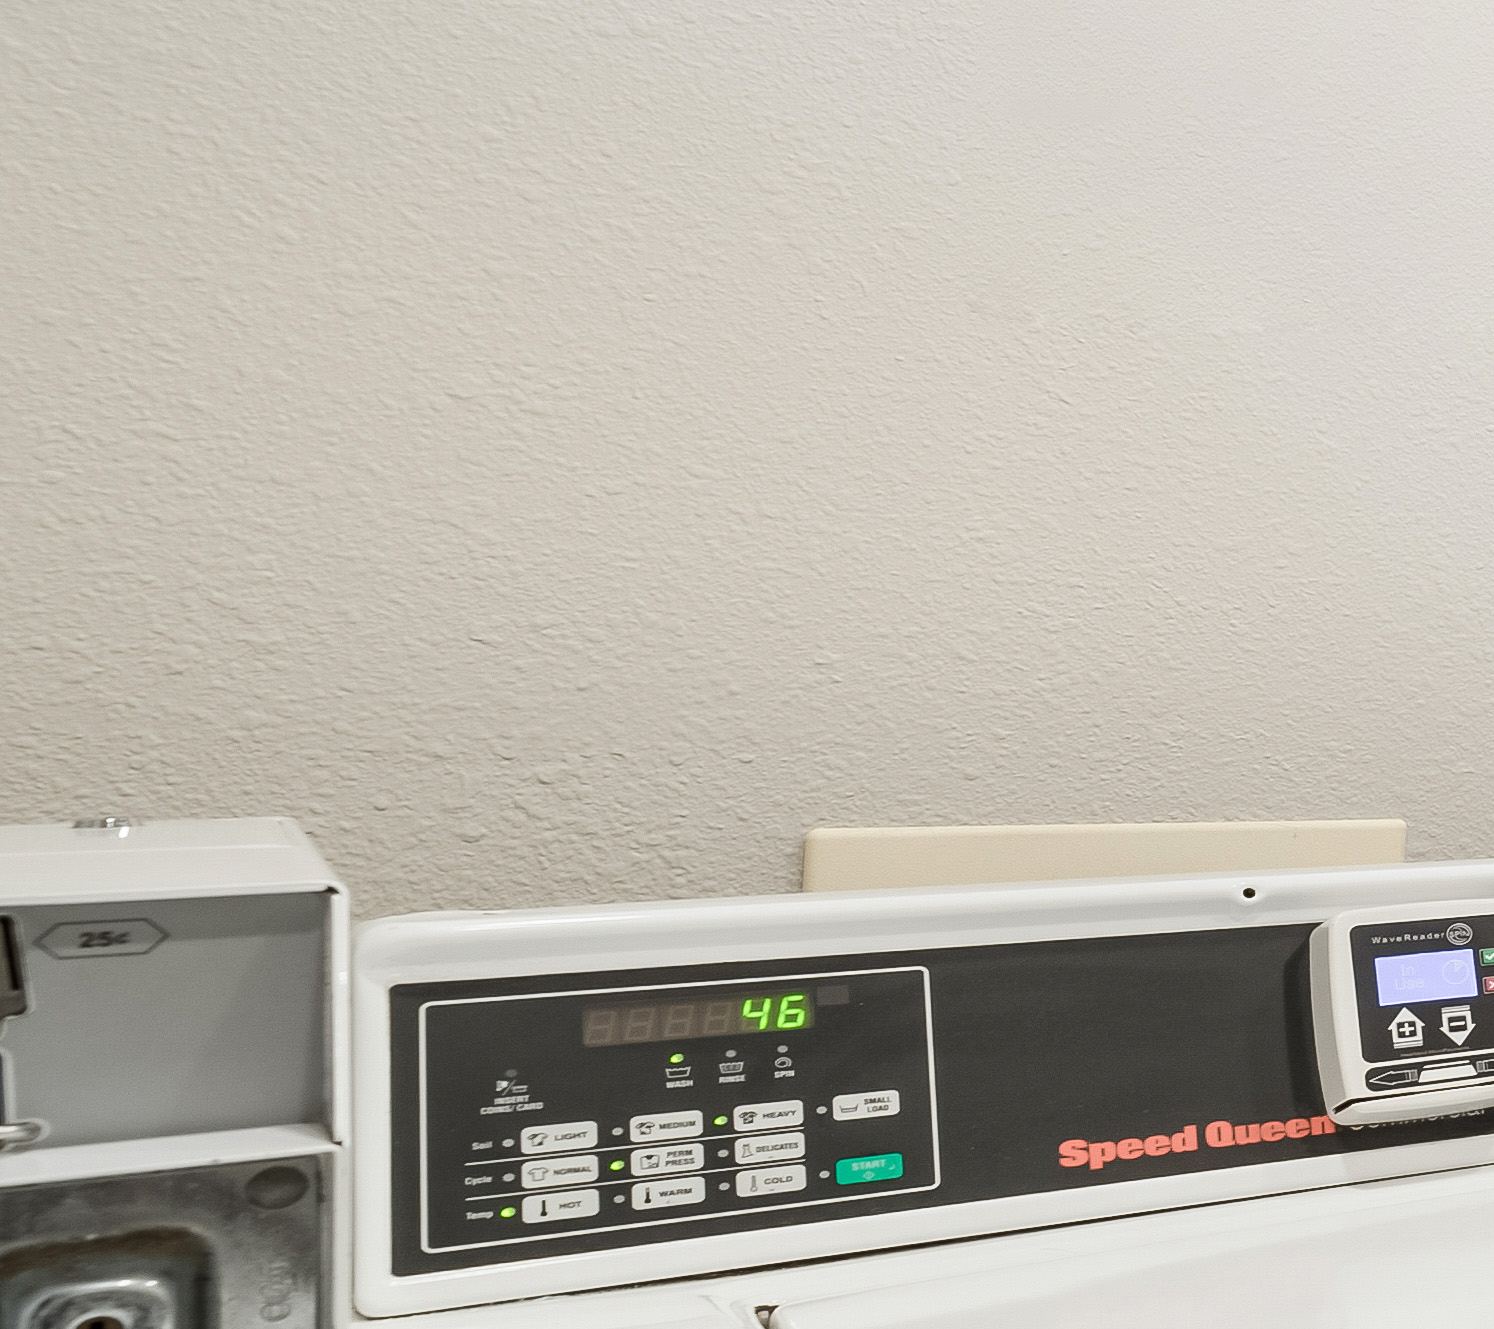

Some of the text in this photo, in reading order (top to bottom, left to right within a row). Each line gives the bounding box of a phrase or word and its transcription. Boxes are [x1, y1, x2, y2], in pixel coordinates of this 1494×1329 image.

[1371, 931, 1445, 945] WaveReader
[742, 994, 806, 1030] 46
[665, 1079, 694, 1089] WASH
[863, 1096, 892, 1105] SMALL
[866, 1104, 890, 1113] LOAD
[762, 1109, 797, 1120] HEAVY
[658, 1119, 697, 1130] MEDIUM
[554, 1131, 589, 1142] LIGHT
[755, 1142, 799, 1153] DELICATES
[1058, 1124, 1199, 1171] Speed
[1205, 1115, 1336, 1148] Queen
[666, 1149, 694, 1158] PERM
[665, 1157, 696, 1167] PRESS
[851, 1159, 887, 1171] START
[553, 1165, 593, 1176] NORMAL
[763, 1175, 794, 1185] COLD
[658, 1187, 693, 1197] WARM
[558, 1200, 583, 1210] HOT
